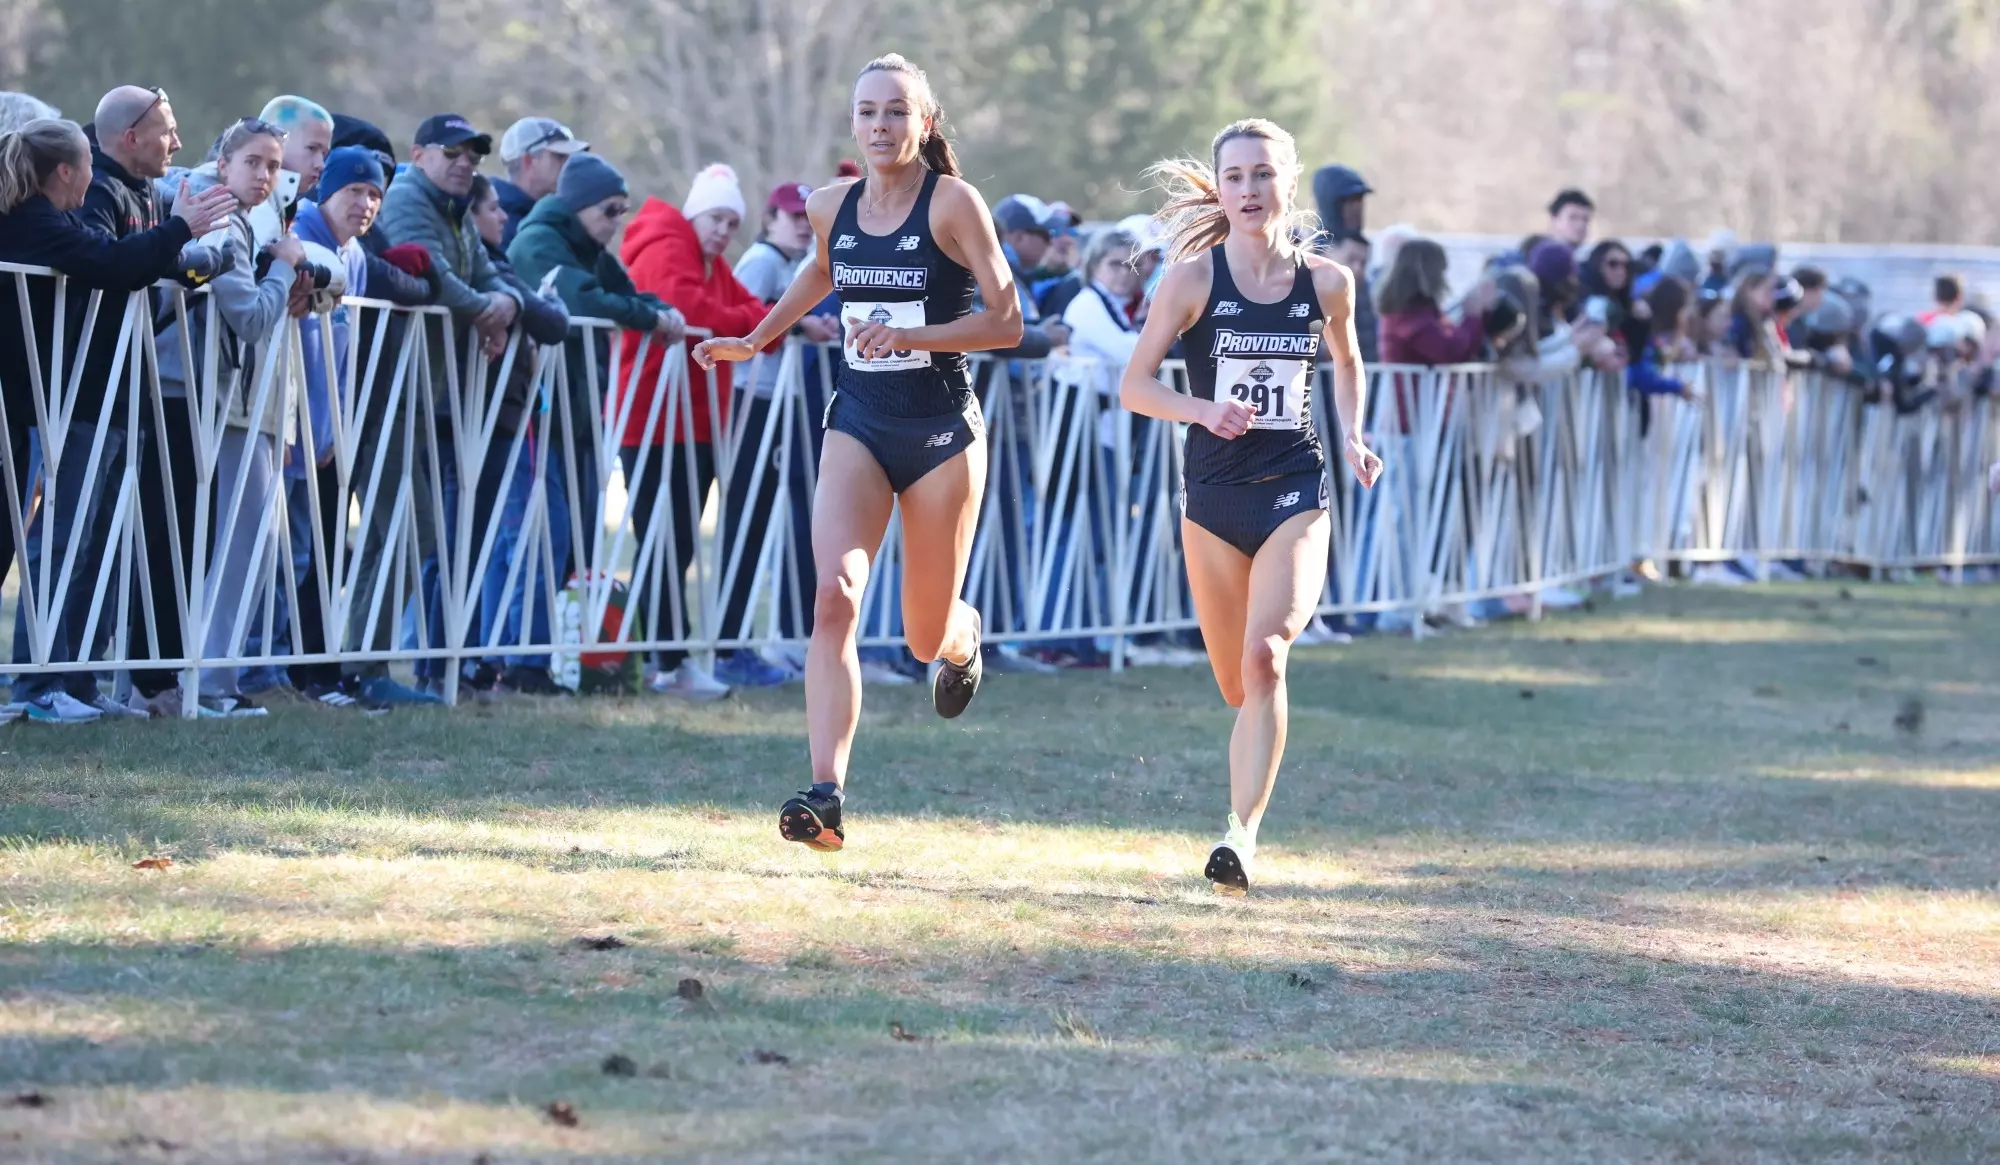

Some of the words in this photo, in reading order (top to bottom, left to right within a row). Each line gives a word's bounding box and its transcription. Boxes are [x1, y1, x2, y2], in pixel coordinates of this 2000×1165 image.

[835, 265, 924, 288] PROVIDENCE
[1217, 300, 1239, 308] BIG
[1214, 332, 1318, 355] PROVIDENCE
[1230, 383, 1285, 417] 291
